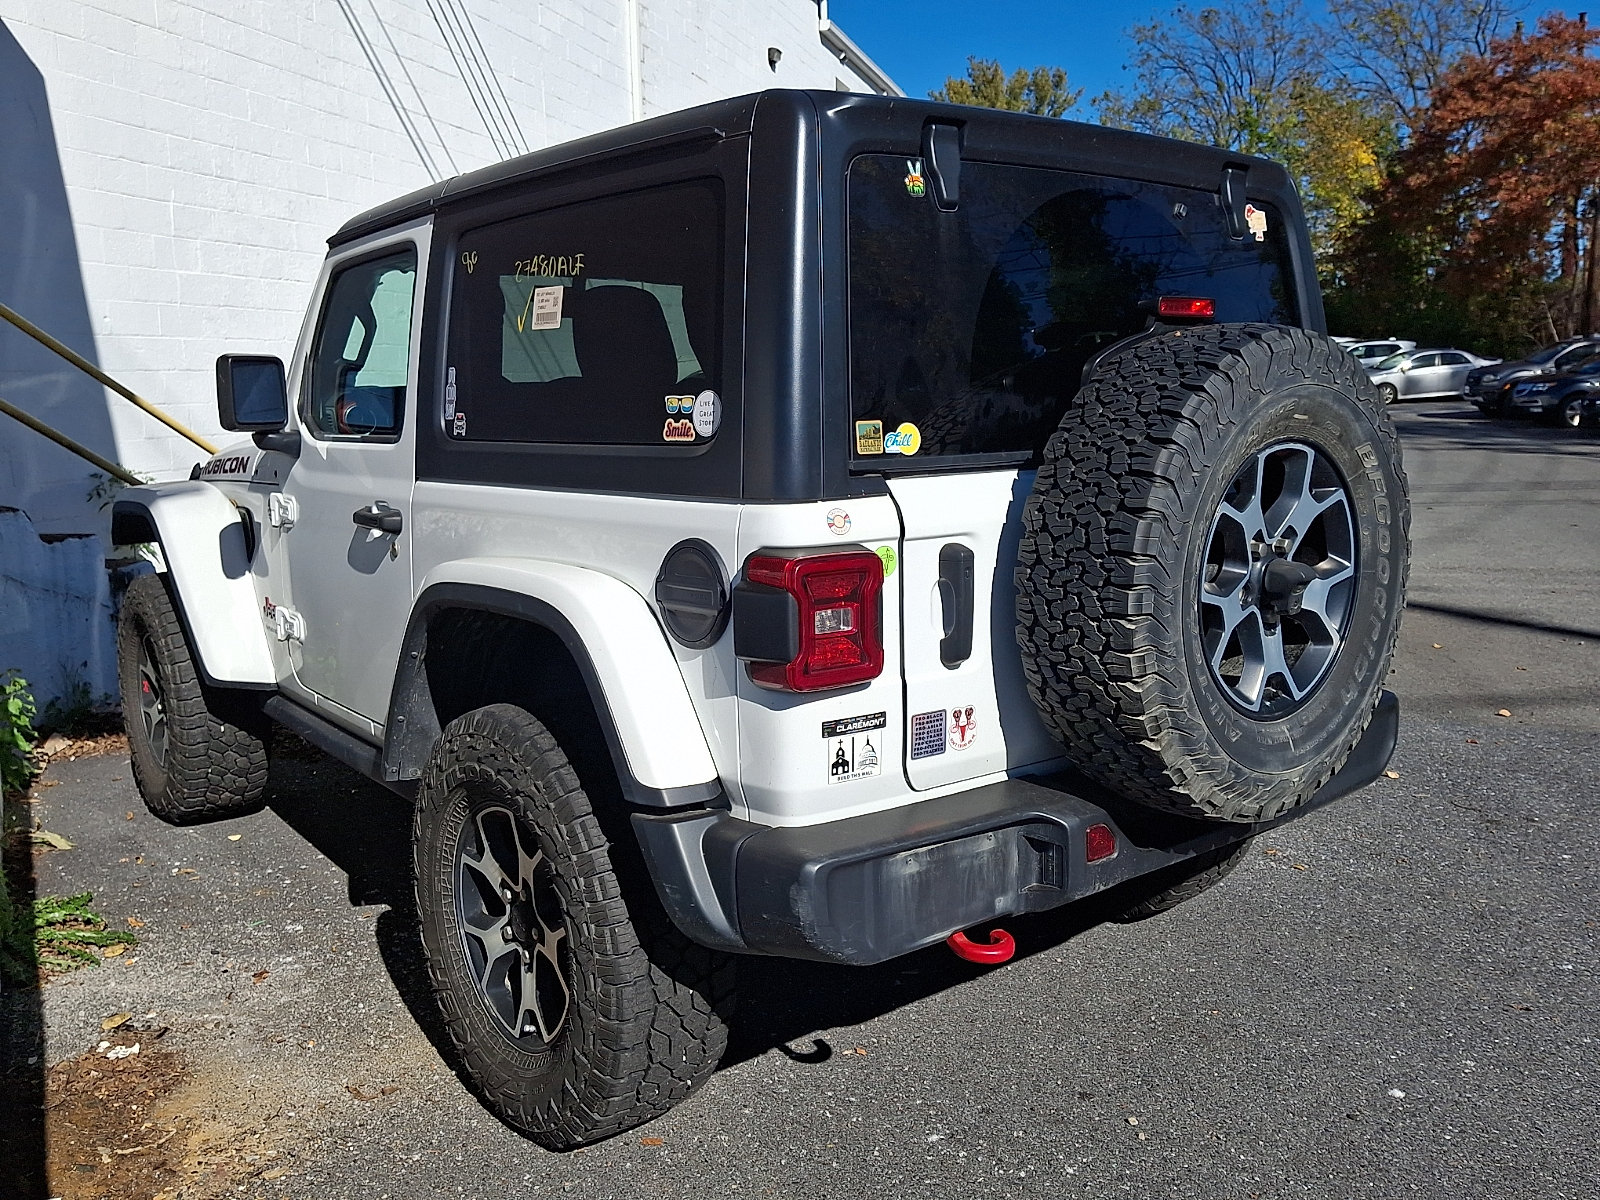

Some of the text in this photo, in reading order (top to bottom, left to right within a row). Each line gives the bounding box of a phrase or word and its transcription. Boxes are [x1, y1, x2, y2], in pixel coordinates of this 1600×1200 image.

[885, 431, 912, 449] Chill
[201, 455, 251, 476] RUBICON
[836, 718, 885, 733] CLAREMONT
